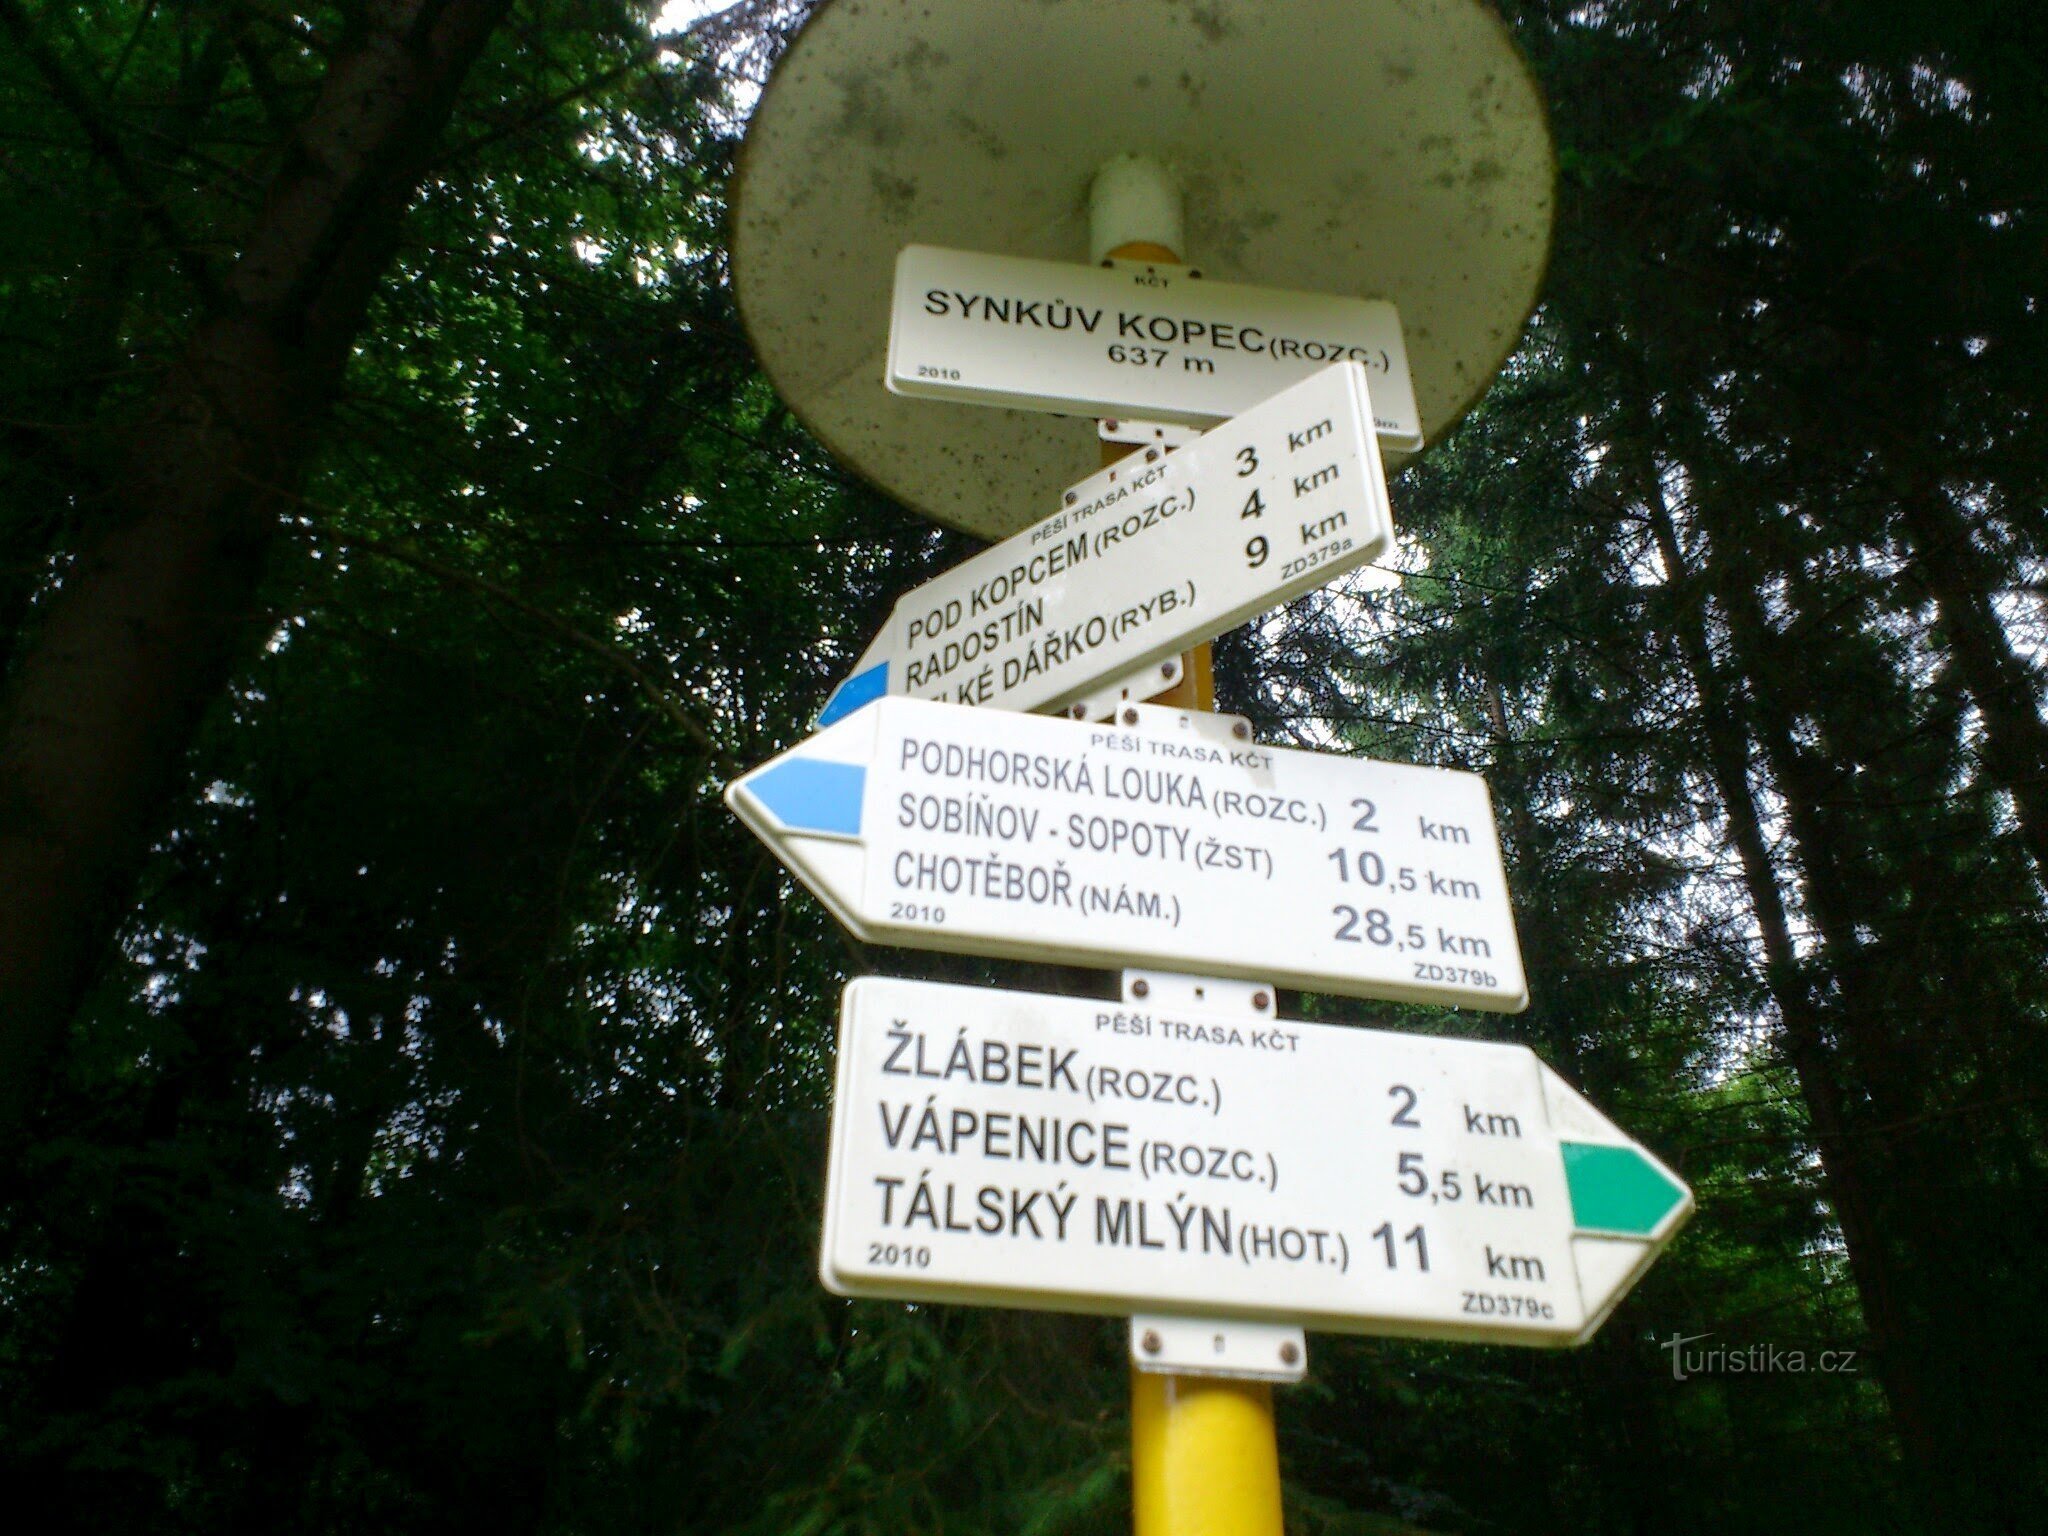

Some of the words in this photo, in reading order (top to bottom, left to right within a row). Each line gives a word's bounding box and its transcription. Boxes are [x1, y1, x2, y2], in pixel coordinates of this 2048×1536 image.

[925, 290, 1102, 332] SYNKŮV
[918, 366, 960, 381] 2010
[1108, 344, 1168, 368] 637
[1184, 356, 1215, 374] m
[1032, 514, 1067, 545] PĚŠÍ
[1073, 487, 1128, 523] TRASA
[1132, 464, 1167, 492] KČT
[908, 600, 961, 649] POD
[1236, 446, 1259, 478] 3
[1288, 419, 1332, 453] km
[1245, 535, 1269, 569] 9
[1301, 511, 1348, 545] km
[906, 598, 1043, 693] RADOSTÍN
[1240, 488, 1266, 520] 4
[1293, 464, 1339, 498] km
[1281, 537, 1353, 580] ZD379a
[1091, 733, 1140, 752] PĚŠÍ
[1149, 741, 1222, 764] TRASA
[1230, 750, 1273, 770] KČT
[901, 738, 1093, 795] PODHORSKÁ
[1350, 799, 1379, 833] 2
[1419, 816, 1470, 844] km
[899, 792, 1038, 842] SOBÍŇOV
[1328, 848, 1417, 893] 10,5
[1428, 871, 1480, 899] km
[891, 902, 945, 923] 2010
[1332, 905, 1425, 952] 28,5
[1438, 928, 1491, 958] km
[1414, 962, 1497, 987] ZD379b
[1096, 1013, 1151, 1035] PĚŠÍ
[1160, 1020, 1244, 1046] TRASA
[1252, 1026, 1299, 1051] KČT
[1389, 1084, 1420, 1127] 2
[1464, 1104, 1521, 1137] km
[1399, 1152, 1462, 1204] 5,5
[1475, 1174, 1533, 1208] km
[875, 1169, 1078, 1241] TÁLSKÝ
[1372, 1221, 1430, 1272] 11
[1485, 1245, 1545, 1281] km
[869, 1243, 931, 1268] 2010
[1463, 1292, 1555, 1319] ZD379c
